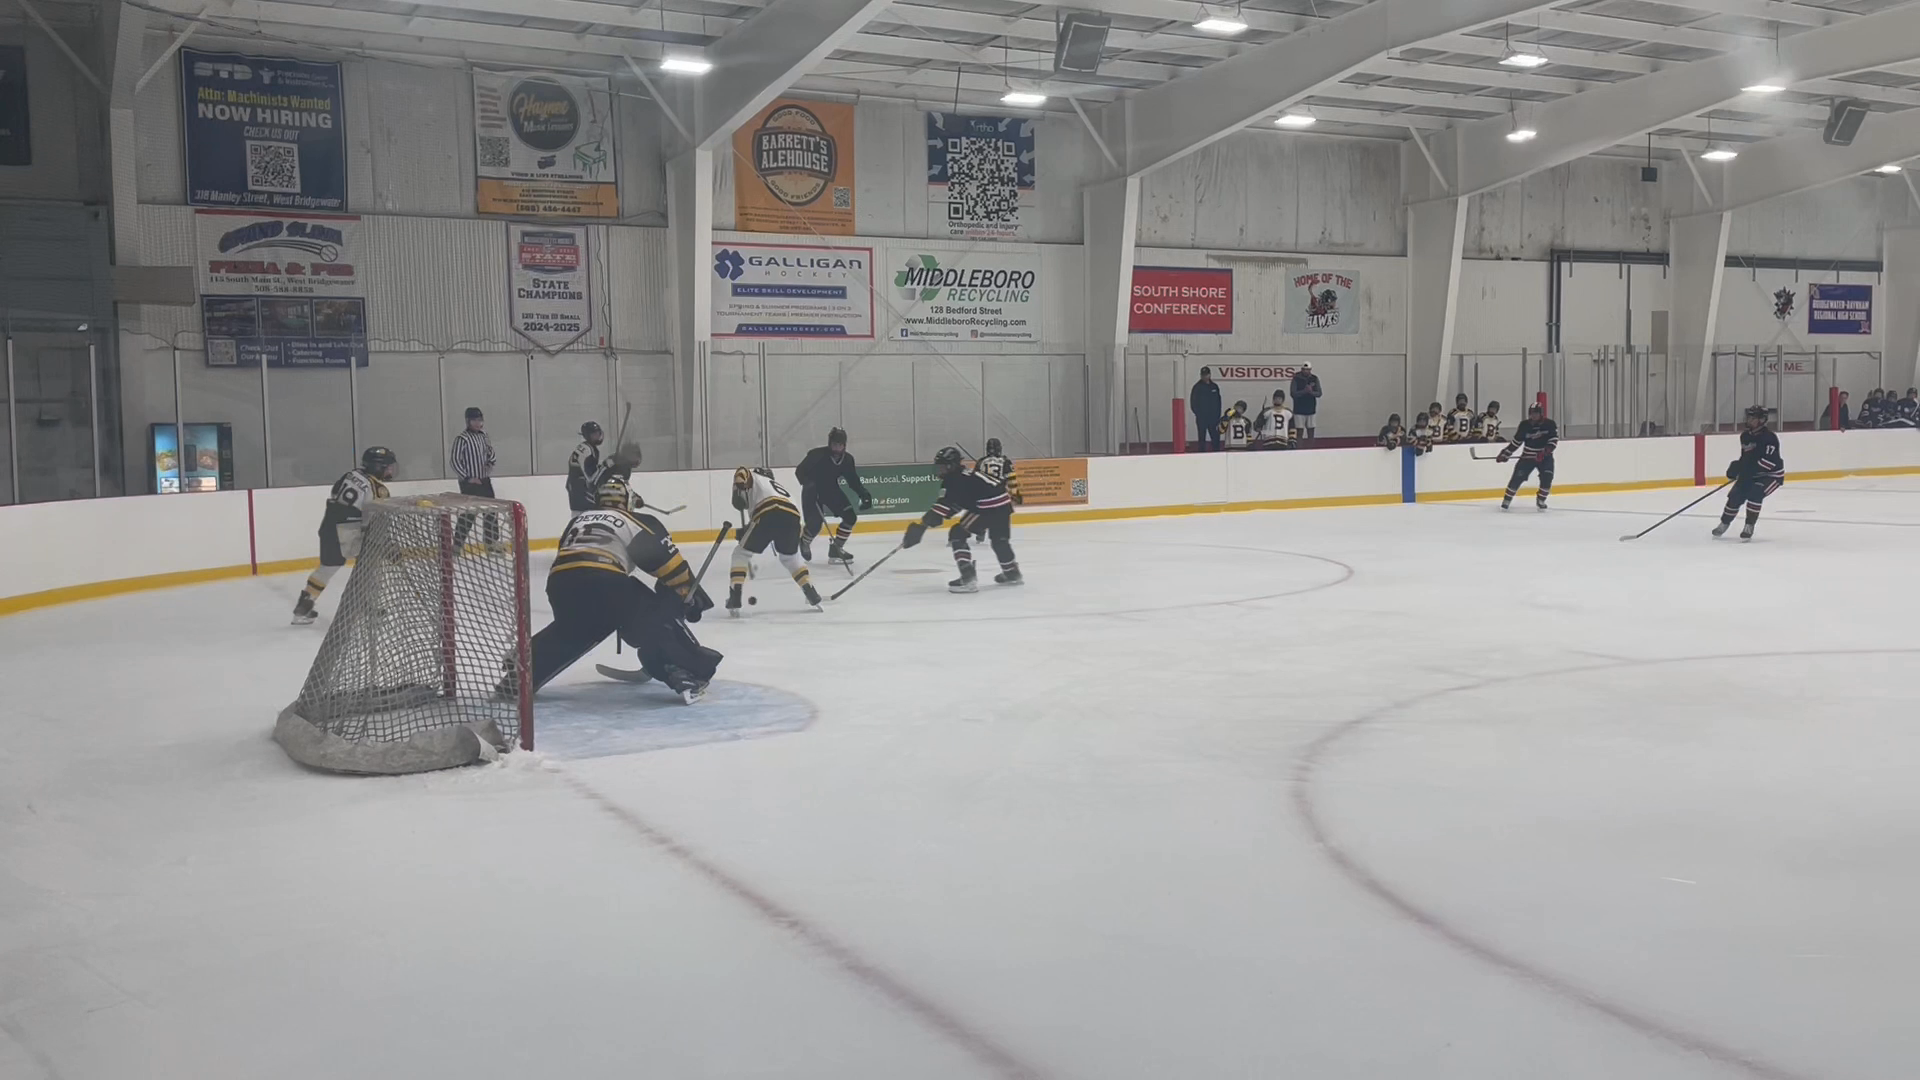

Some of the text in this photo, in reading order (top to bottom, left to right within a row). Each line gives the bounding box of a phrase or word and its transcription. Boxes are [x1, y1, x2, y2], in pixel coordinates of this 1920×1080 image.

[198, 87, 330, 110] Attn: Machinists Wanted
[198, 103, 332, 128] NOW HIRING
[772, 110, 816, 126] GOOD FOOD
[244, 126, 300, 141] CHECK US OUT
[762, 134, 828, 154] BARRETT'S
[762, 150, 828, 172] ALEHOUSE
[770, 180, 821, 200] GOOD FRIENDS
[210, 190, 242, 204] Manley
[273, 194, 293, 206] West
[294, 194, 341, 208] Bridgewater
[948, 221, 984, 230] Orthopedic
[748, 256, 862, 270] GALLIGAN
[532, 278, 569, 290] STATE
[904, 267, 1036, 290] MIDDLEBORO
[1293, 273, 1353, 290] HOME OF THE
[518, 288, 583, 300] CHAMPIONS
[946, 288, 1030, 302] RECYCLING
[1133, 285, 1227, 298] SOUTH SHORE
[946, 306, 977, 314] Bedford
[979, 307, 1002, 315] Street
[1133, 302, 1226, 316] CONFERENCE
[523, 322, 580, 332] 2024-2025
[1306, 311, 1340, 329] HAWKS
[1219, 367, 1296, 378] VISITORS
[1273, 414, 1285, 430] B
[1459, 418, 1469, 432] B
[1232, 424, 1244, 439] B
[1766, 445, 1776, 455] 17
[860, 476, 878, 484] Bank
[901, 474, 931, 484] Support
